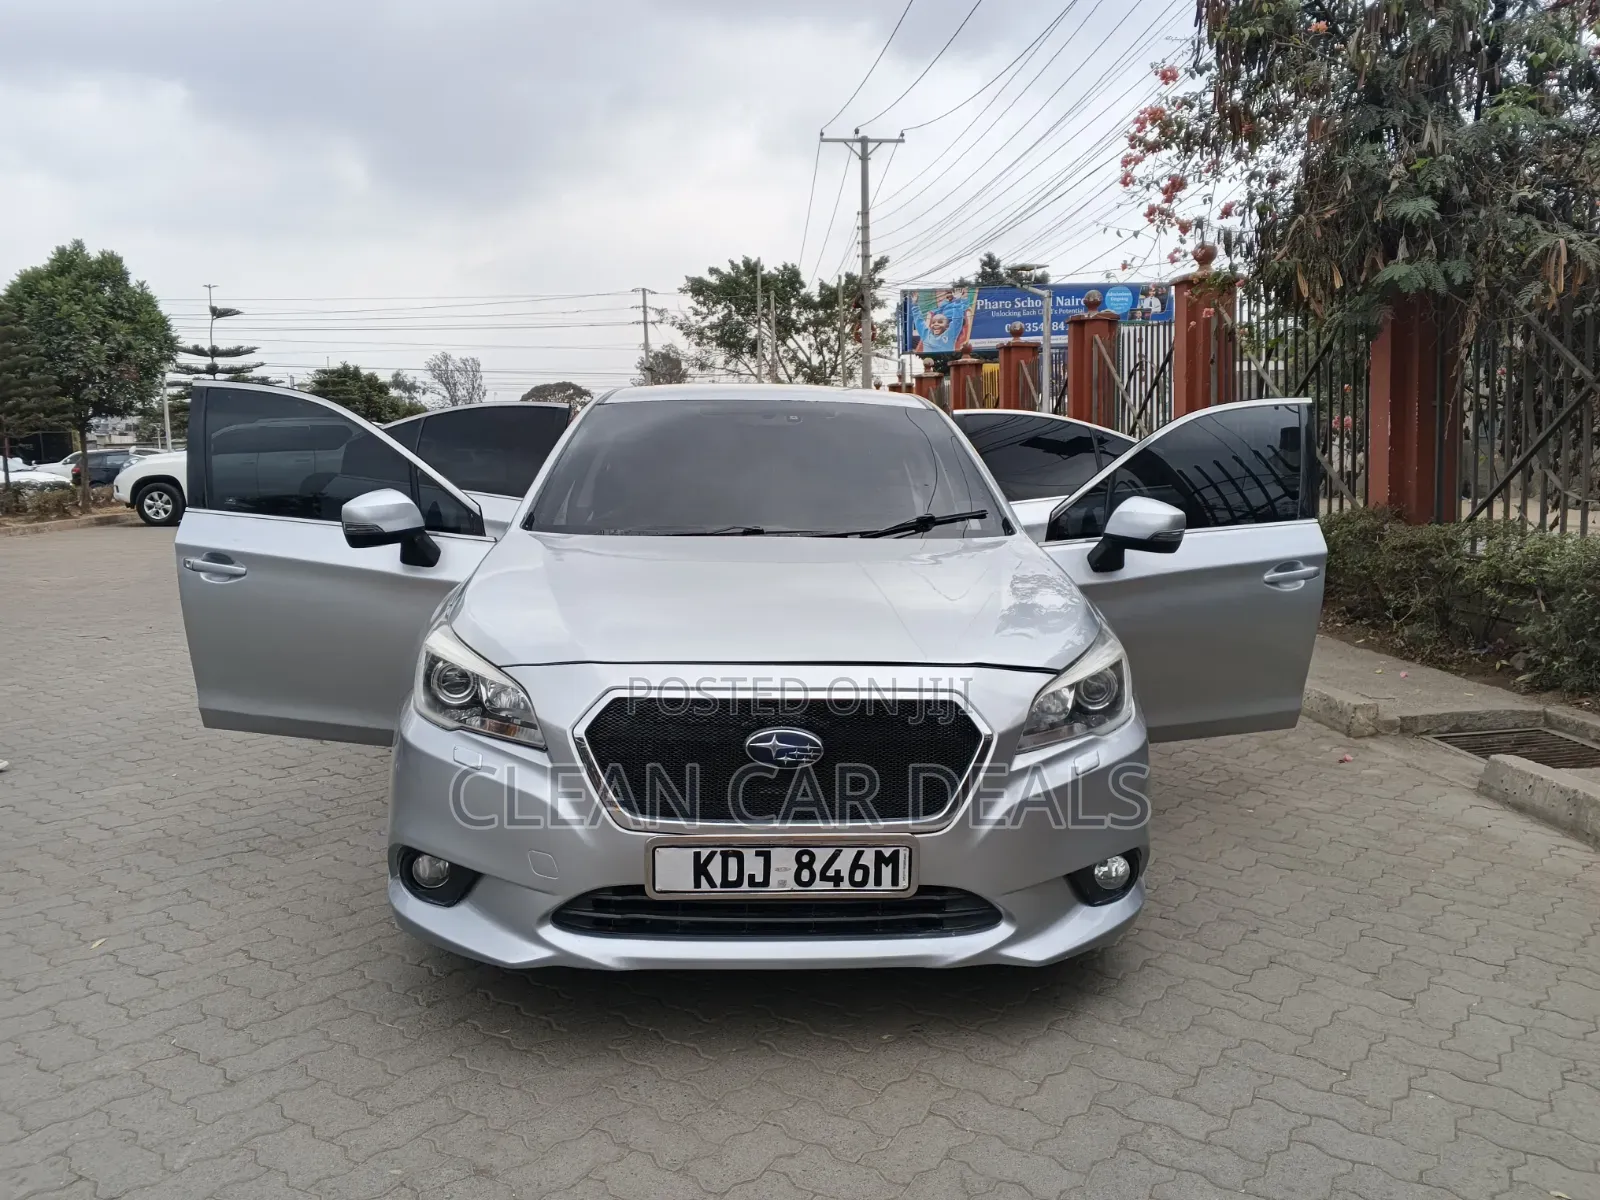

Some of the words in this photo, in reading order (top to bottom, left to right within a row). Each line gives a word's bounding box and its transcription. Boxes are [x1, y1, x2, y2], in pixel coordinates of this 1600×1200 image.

[976, 299, 1012, 310] Pharo
[1014, 297, 1053, 308] Schol
[991, 309, 1021, 318] Unlocking
[1058, 307, 1085, 315] Potential
[693, 850, 772, 889] KDJ
[794, 849, 900, 888] 846M
